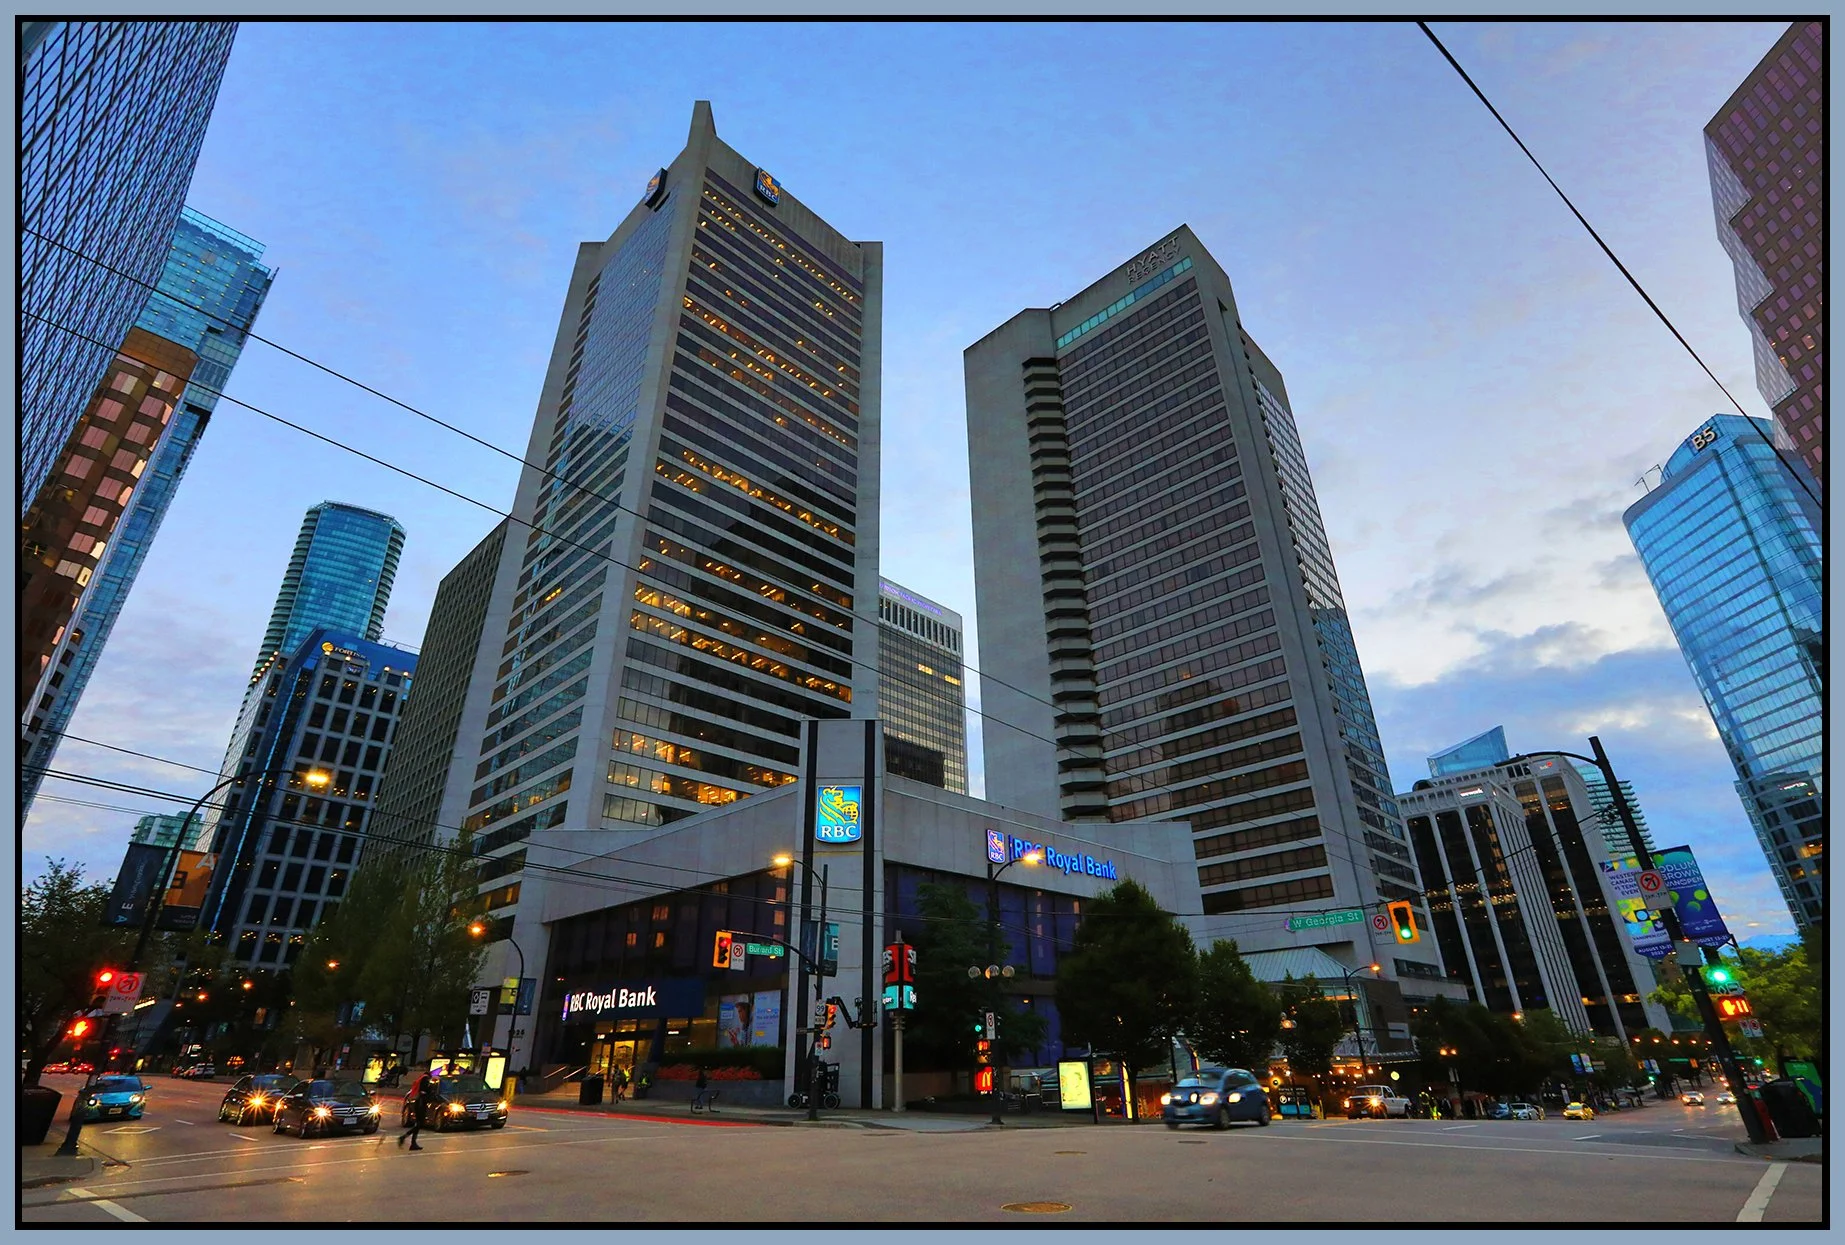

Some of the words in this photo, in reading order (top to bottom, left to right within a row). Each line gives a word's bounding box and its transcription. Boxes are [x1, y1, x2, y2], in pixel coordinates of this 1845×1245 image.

[760, 184, 777, 200] RBC
[1126, 236, 1179, 276] HYATT
[1128, 246, 1181, 285] REGENCY
[1691, 426, 1717, 451] B5
[821, 825, 856, 838] RBC
[990, 851, 1003, 861] RBC
[1046, 846, 1083, 875] Royal
[1085, 855, 1117, 880] Bank
[1658, 860, 1697, 873] ODLUM
[1609, 870, 1639, 880] WESTER
[1610, 877, 1635, 886] CANAD
[1621, 882, 1638, 890] TENN
[1293, 919, 1302, 928] W
[1305, 915, 1344, 928] Georgia
[1347, 912, 1359, 921] St
[774, 947, 782, 955] St
[569, 992, 585, 1013] RBC
[585, 989, 617, 1015] Royal
[618, 985, 657, 1008] Bank
[816, 1005, 825, 1013] 99
